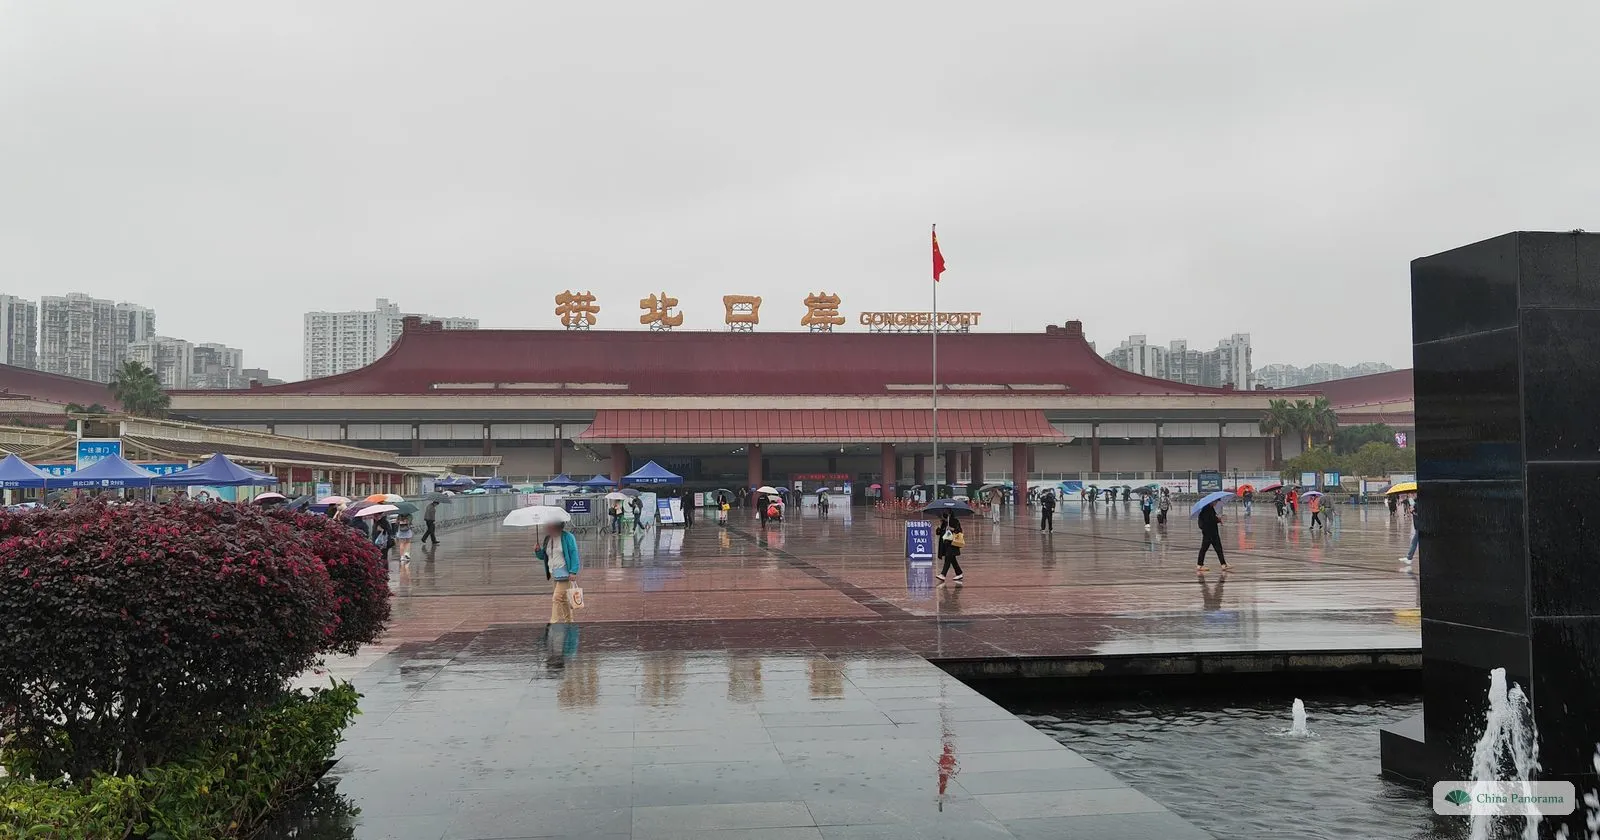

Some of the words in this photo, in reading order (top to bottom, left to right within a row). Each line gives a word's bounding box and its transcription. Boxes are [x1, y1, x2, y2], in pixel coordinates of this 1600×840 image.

[555, 290, 845, 331] 拱北口岸
[860, 312, 932, 325] GONGBEI
[937, 312, 981, 325] PORT
